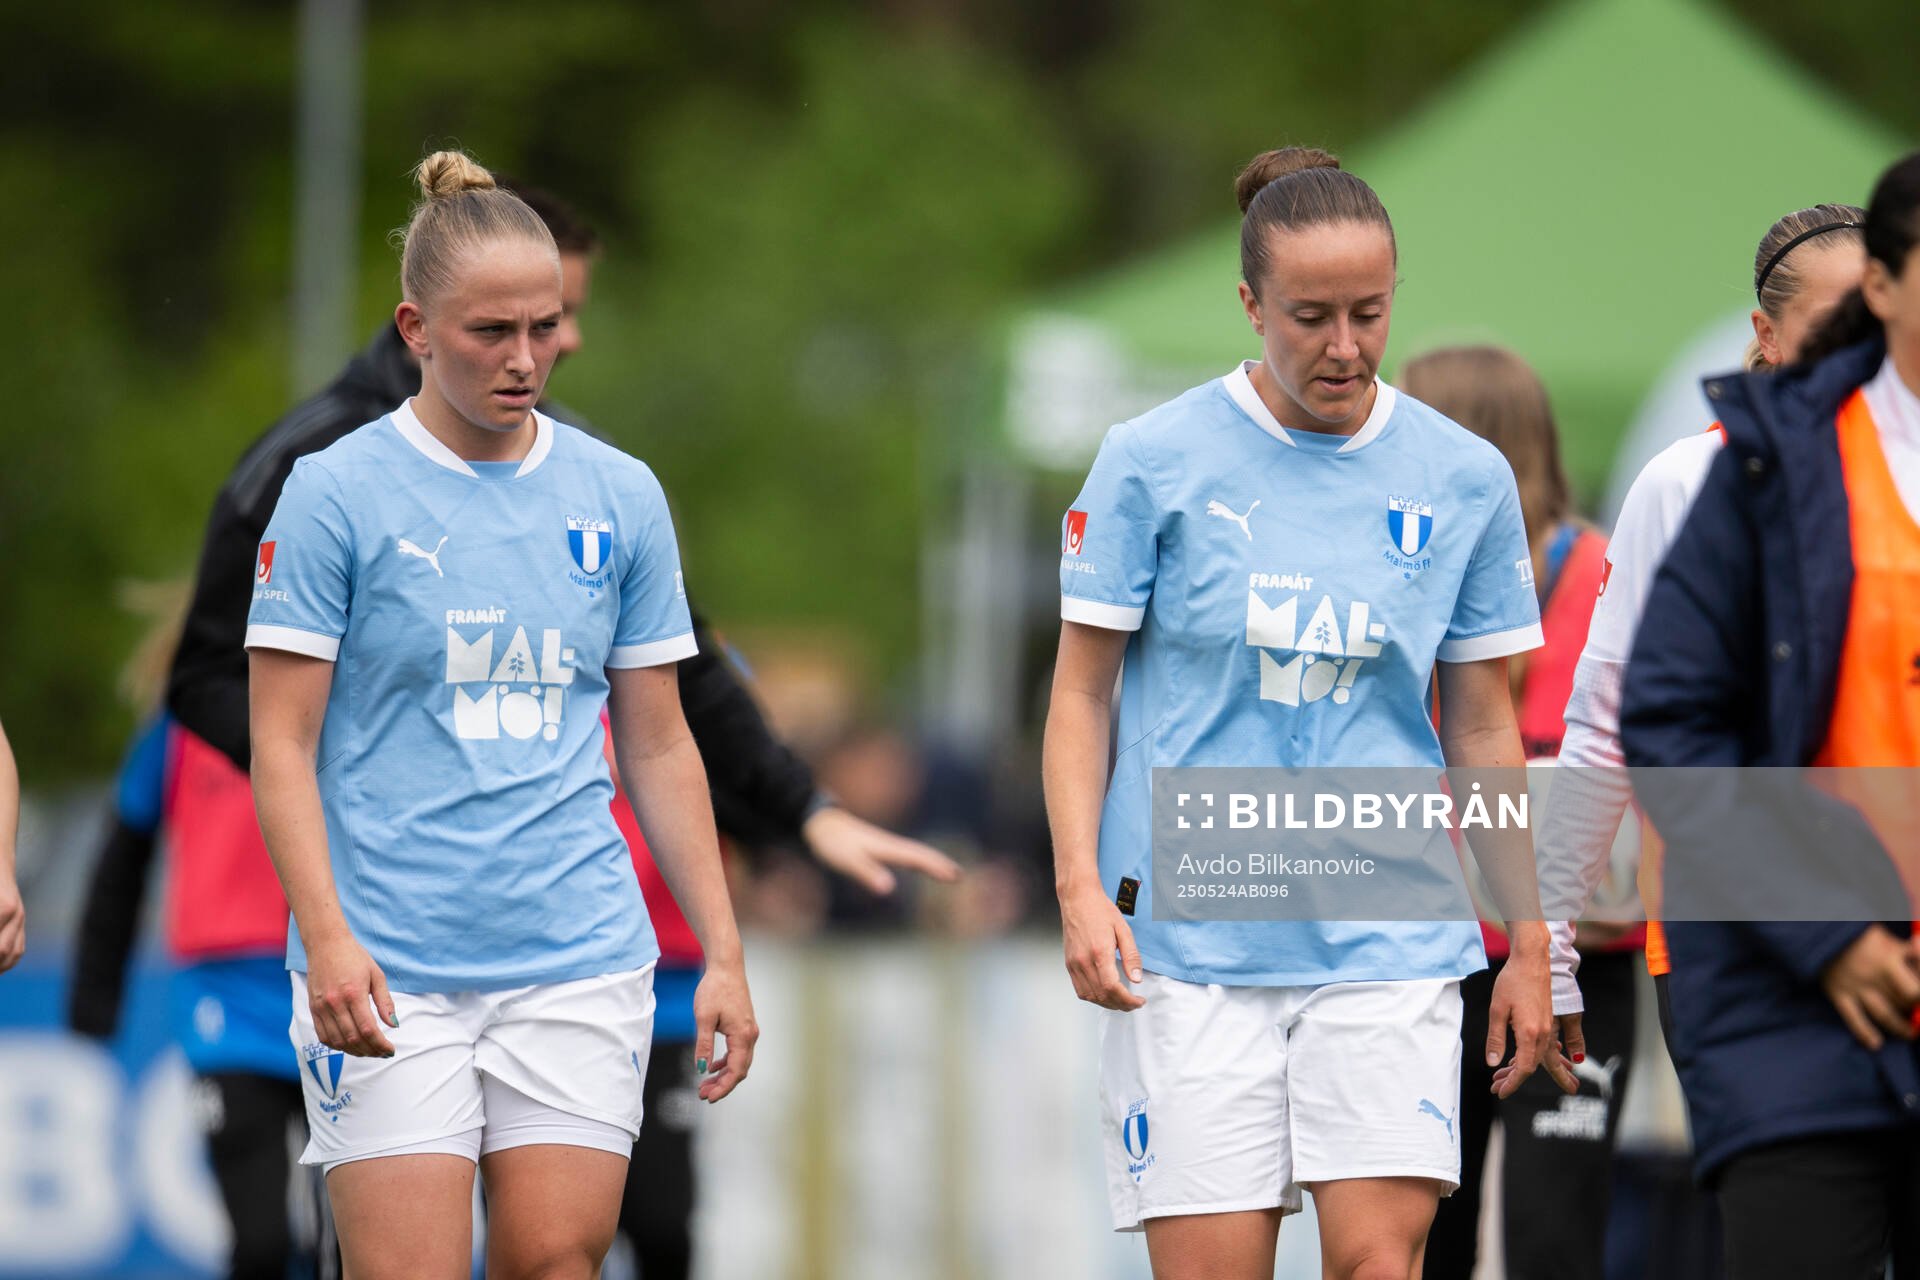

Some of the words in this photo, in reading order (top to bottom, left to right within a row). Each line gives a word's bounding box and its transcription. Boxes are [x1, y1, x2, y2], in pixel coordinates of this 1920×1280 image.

[1384, 550, 1421, 572] Malmö
[1249, 572, 1314, 591] FRAMÅT
[263, 589, 290, 602] SPEL
[445, 605, 507, 624] FRAMÅT
